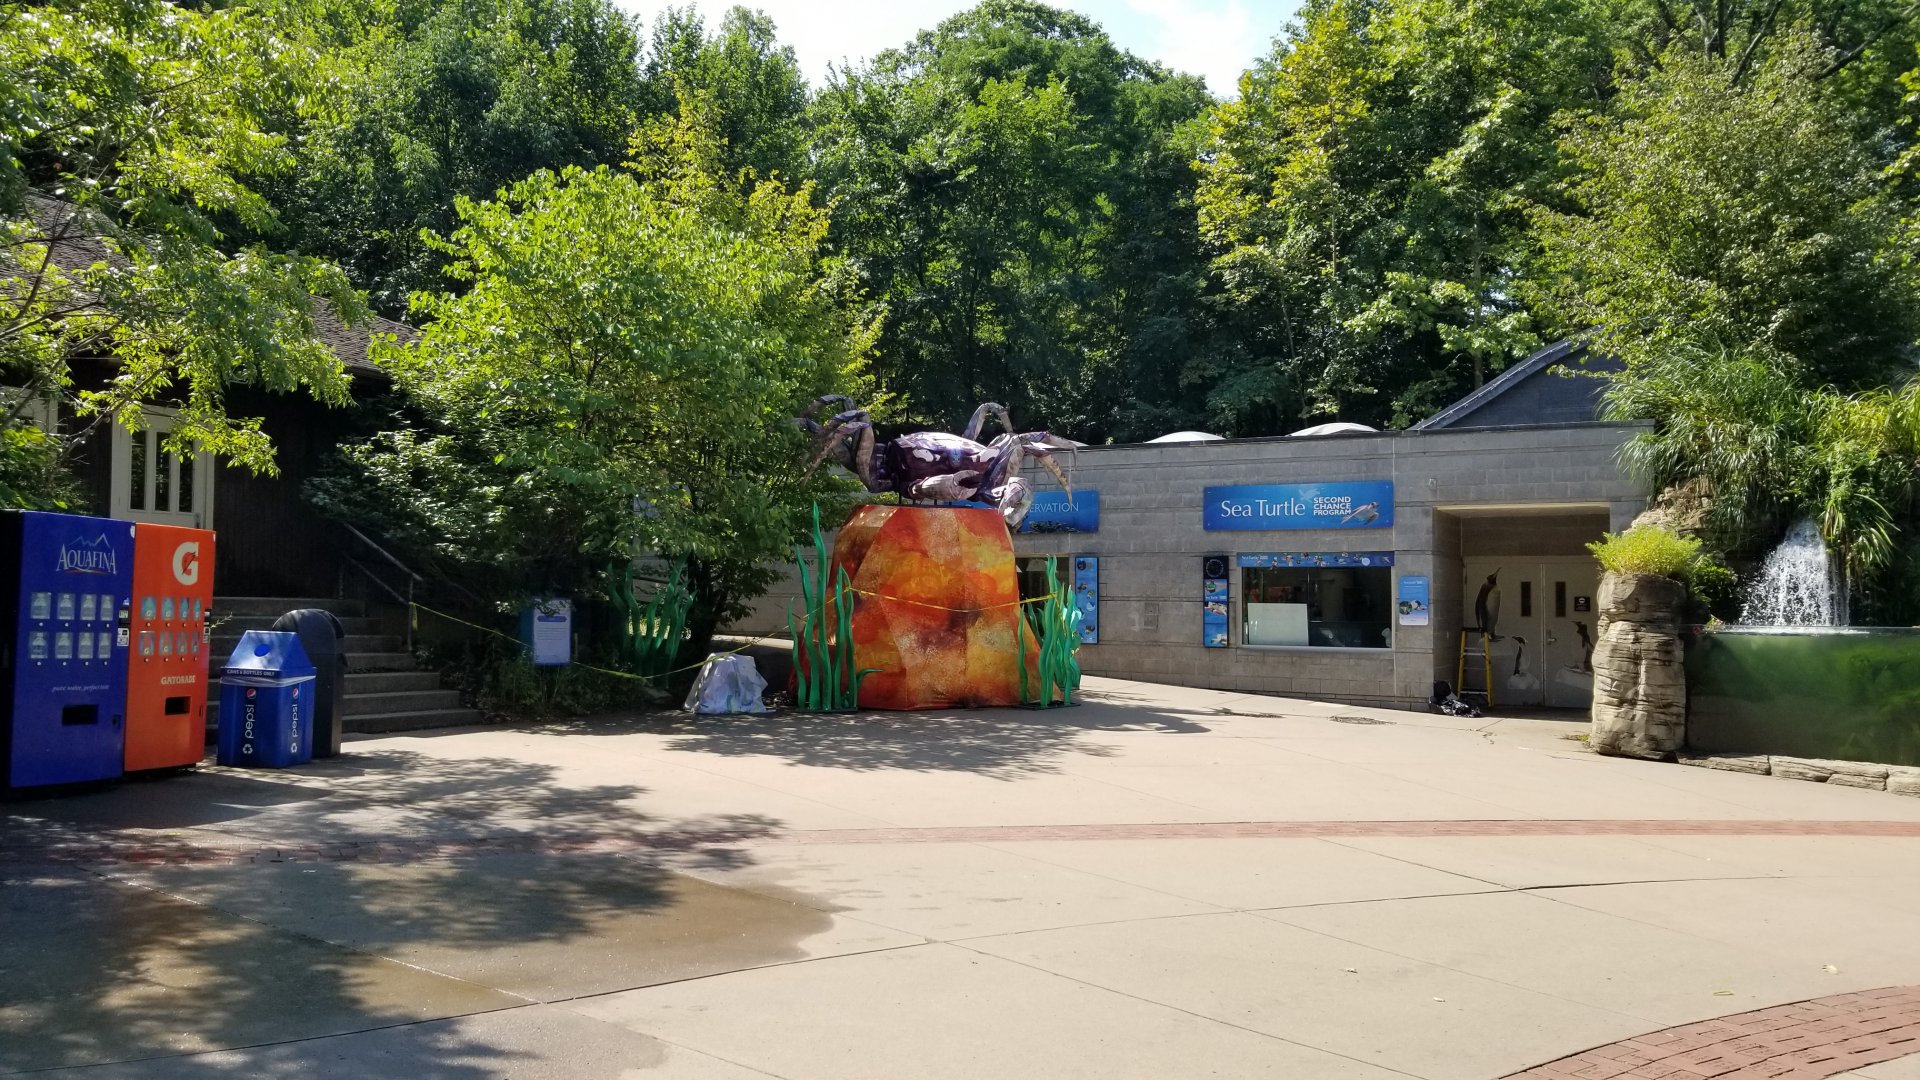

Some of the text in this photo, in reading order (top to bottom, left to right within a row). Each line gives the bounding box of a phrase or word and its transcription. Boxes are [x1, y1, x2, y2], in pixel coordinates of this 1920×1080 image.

[1221, 498, 1306, 517] Sea Turtle
[1313, 496, 1351, 504] SECOND
[56, 544, 117, 574] AQUAFINA
[172, 541, 199, 586] G
[245, 704, 256, 739] pepsi
[291, 703, 299, 738] pepsi
